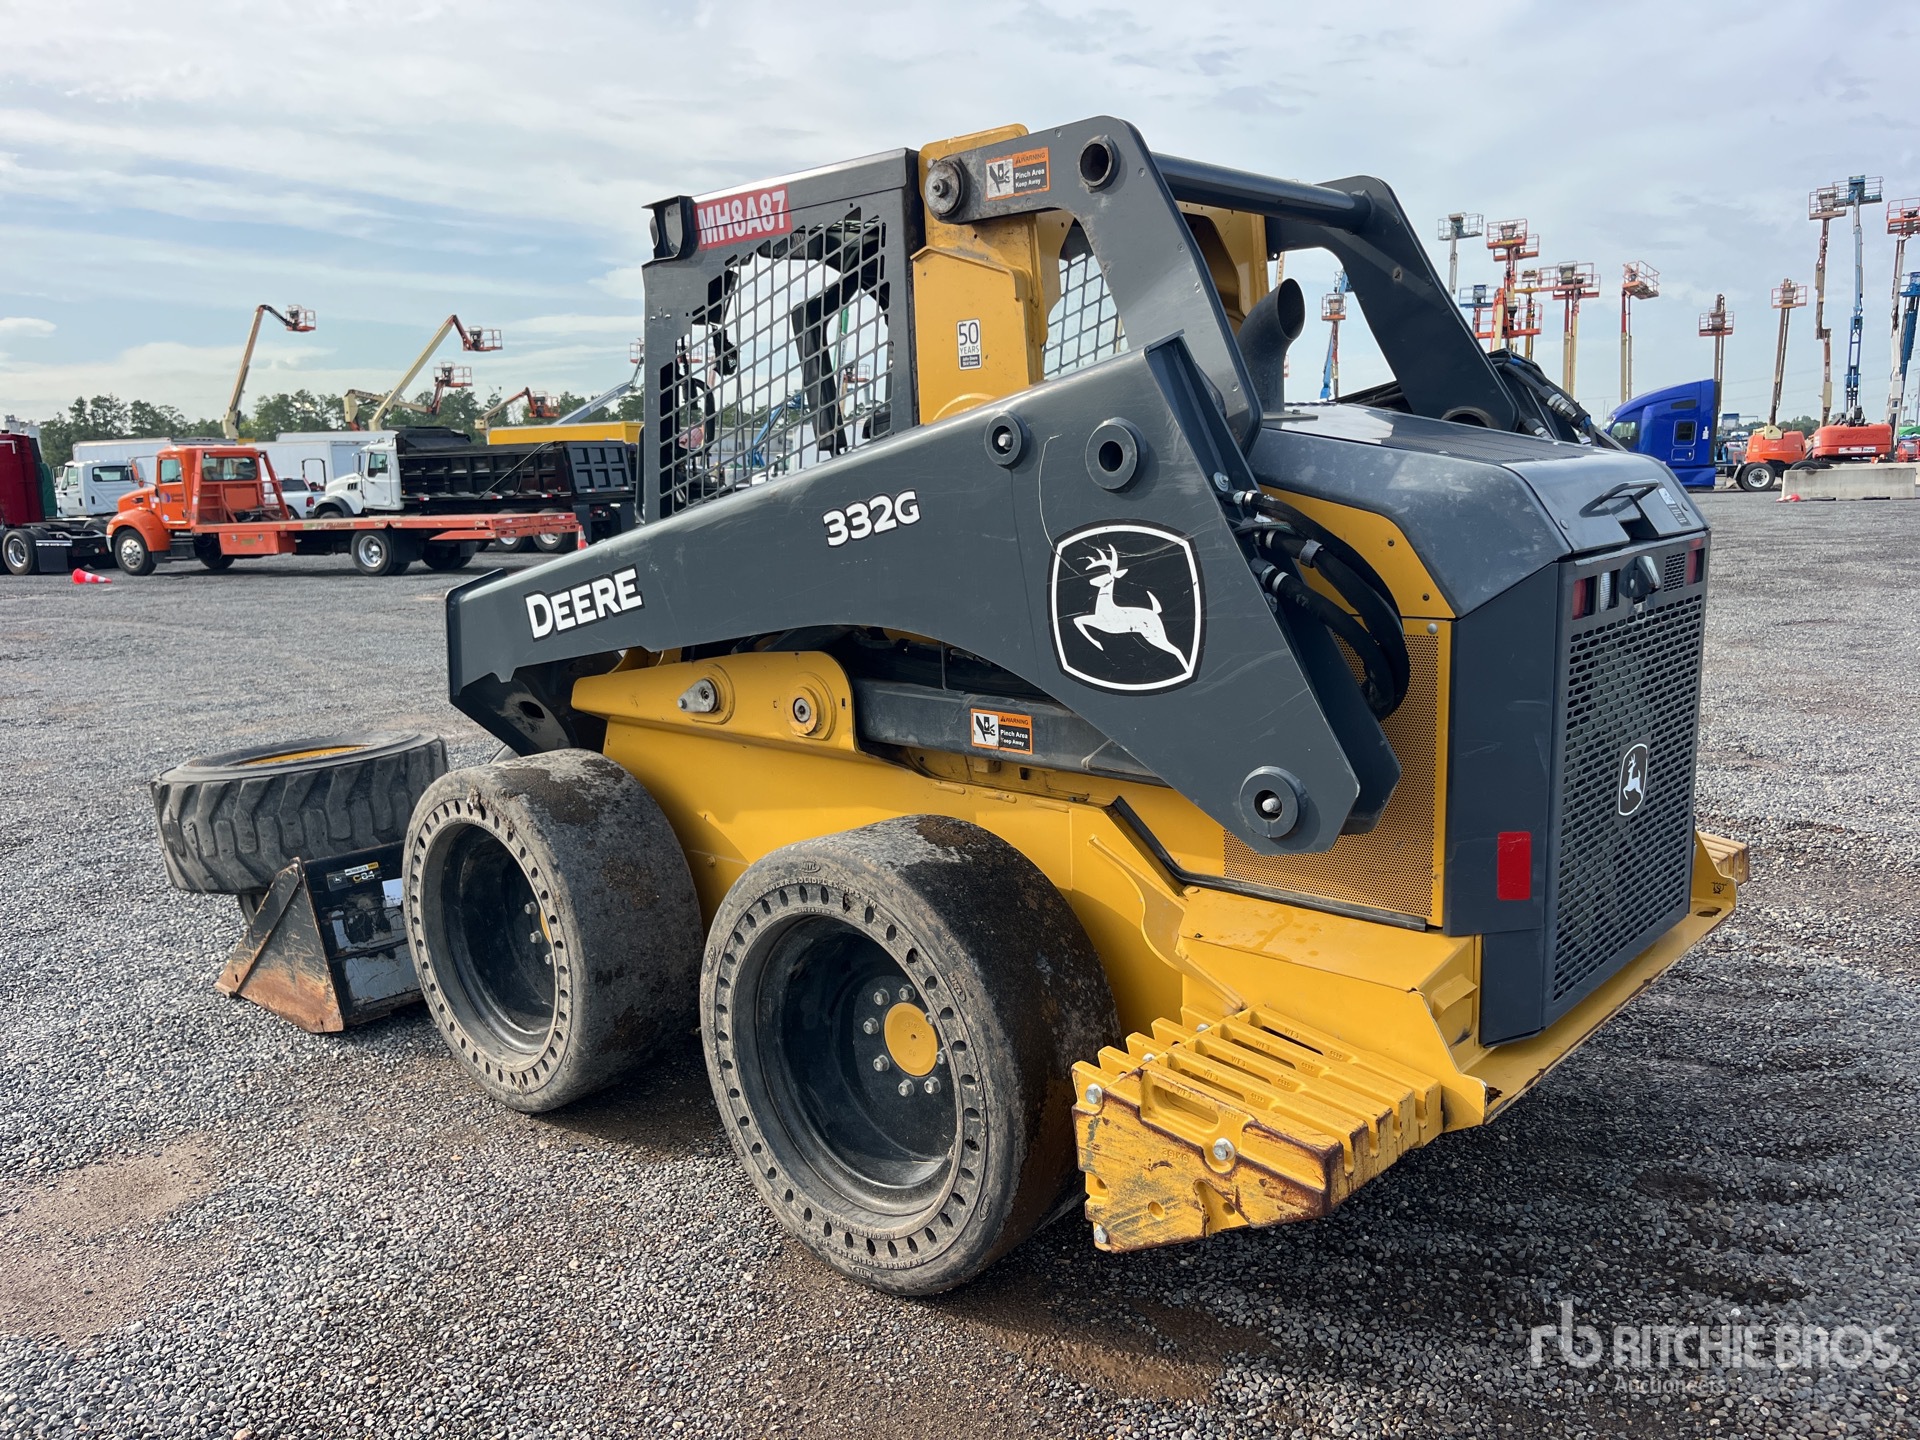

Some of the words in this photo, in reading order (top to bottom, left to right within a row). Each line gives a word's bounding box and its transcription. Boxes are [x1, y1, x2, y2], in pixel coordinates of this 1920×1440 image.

[1021, 153, 1046, 163] WARNING
[1015, 170, 1031, 179] Pinch
[698, 190, 785, 245] MH8A87
[958, 322, 979, 346] 50
[960, 345, 980, 355] YEARS
[822, 488, 921, 547] 332G
[524, 567, 643, 639] DEERE
[1005, 717, 1029, 725] WARNING
[1000, 729, 1015, 737] Pinch
[1015, 731, 1028, 739] Area
[1012, 739, 1025, 747] Away
